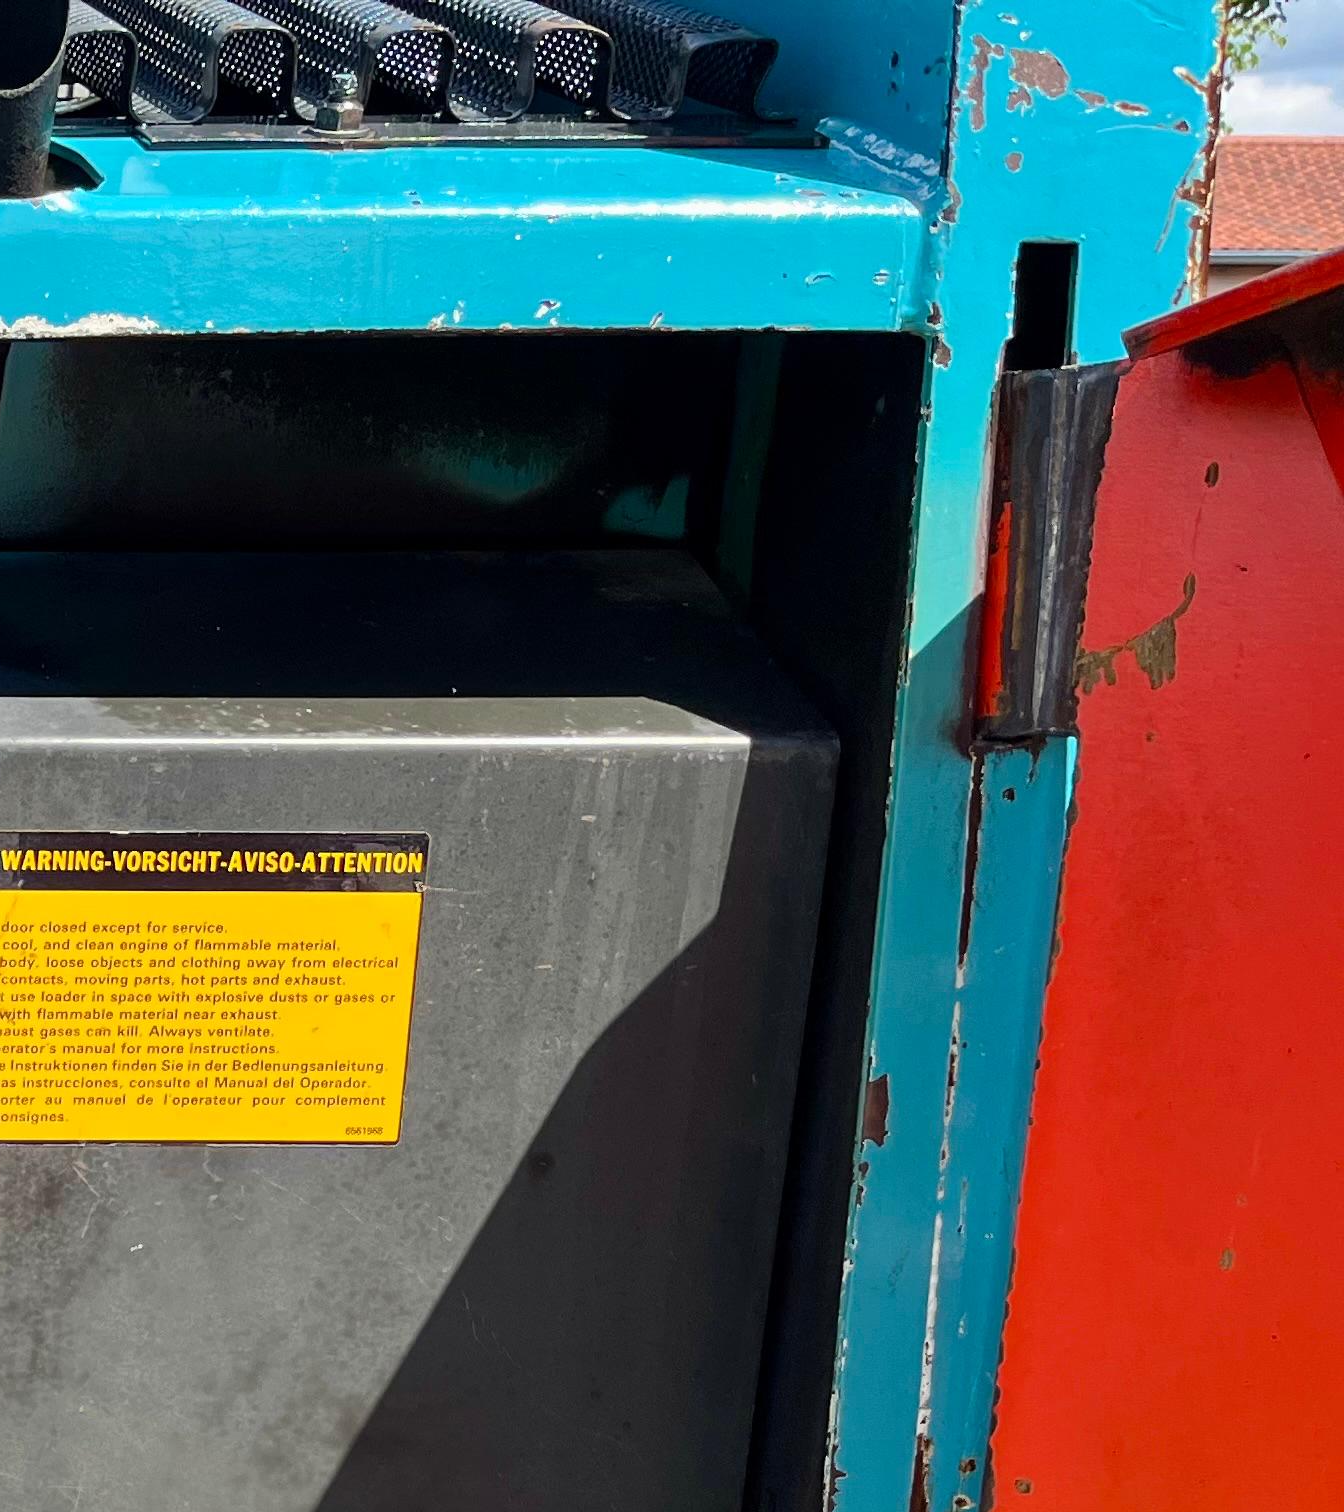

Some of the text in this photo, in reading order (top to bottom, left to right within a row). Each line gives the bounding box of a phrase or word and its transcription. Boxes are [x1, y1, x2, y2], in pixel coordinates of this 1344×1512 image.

[0, 849, 424, 874] WARNING-VORSICHT-AVISO-ATTENTION
[0, 920, 35, 934] door
[39, 920, 89, 934] closed
[91, 922, 142, 936] except
[146, 920, 169, 934] for
[43, 938, 71, 951] and
[75, 938, 115, 952] clean
[119, 938, 169, 954] engine
[172, 938, 191, 953] of
[194, 938, 272, 952] flammable
[45, 955, 85, 969] loose
[90, 955, 144, 971] objects
[148, 955, 176, 969] and
[181, 955, 241, 971] clothing
[246, 959, 287, 971] away
[291, 955, 326, 969] from
[331, 955, 399, 969] electrical
[74, 973, 129, 988] moving
[180, 973, 206, 987] hot
[210, 975, 248, 989] parts
[252, 973, 280, 986] and
[10, 992, 36, 1003] use
[40, 990, 88, 1003] loader
[91, 990, 105, 1003] in
[109, 991, 153, 1006] space
[157, 990, 190, 1004] with
[195, 990, 264, 1006] explosive
[268, 990, 309, 1004] dusts
[312, 993, 330, 1004] or
[333, 992, 377, 1007] gases
[380, 993, 396, 1004] or
[0, 1007, 31, 1021] with
[36, 1007, 114, 1021] flammable
[119, 1007, 179, 1021] material
[183, 1010, 217, 1021] near
[39, 1027, 81, 1040] gases
[85, 1026, 112, 1038] can
[148, 1024, 203, 1040] Always
[62, 1041, 116, 1055] manual
[120, 1041, 143, 1056] for
[146, 1044, 185, 1055] more
[10, 1058, 108, 1073] Instruktionen
[111, 1058, 158, 1073] finden
[160, 1059, 184, 1072] Sie
[187, 1059, 201, 1073] in
[204, 1059, 229, 1072] der
[128, 1076, 192, 1089] consulte
[195, 1076, 209, 1089] el
[213, 1076, 269, 1089] Manual
[272, 1076, 295, 1089] del
[44, 1096, 63, 1106] au
[72, 1093, 127, 1107] manuel
[135, 1093, 154, 1106] de
[251, 1096, 287, 1109] pour
[295, 1094, 387, 1109] complement
